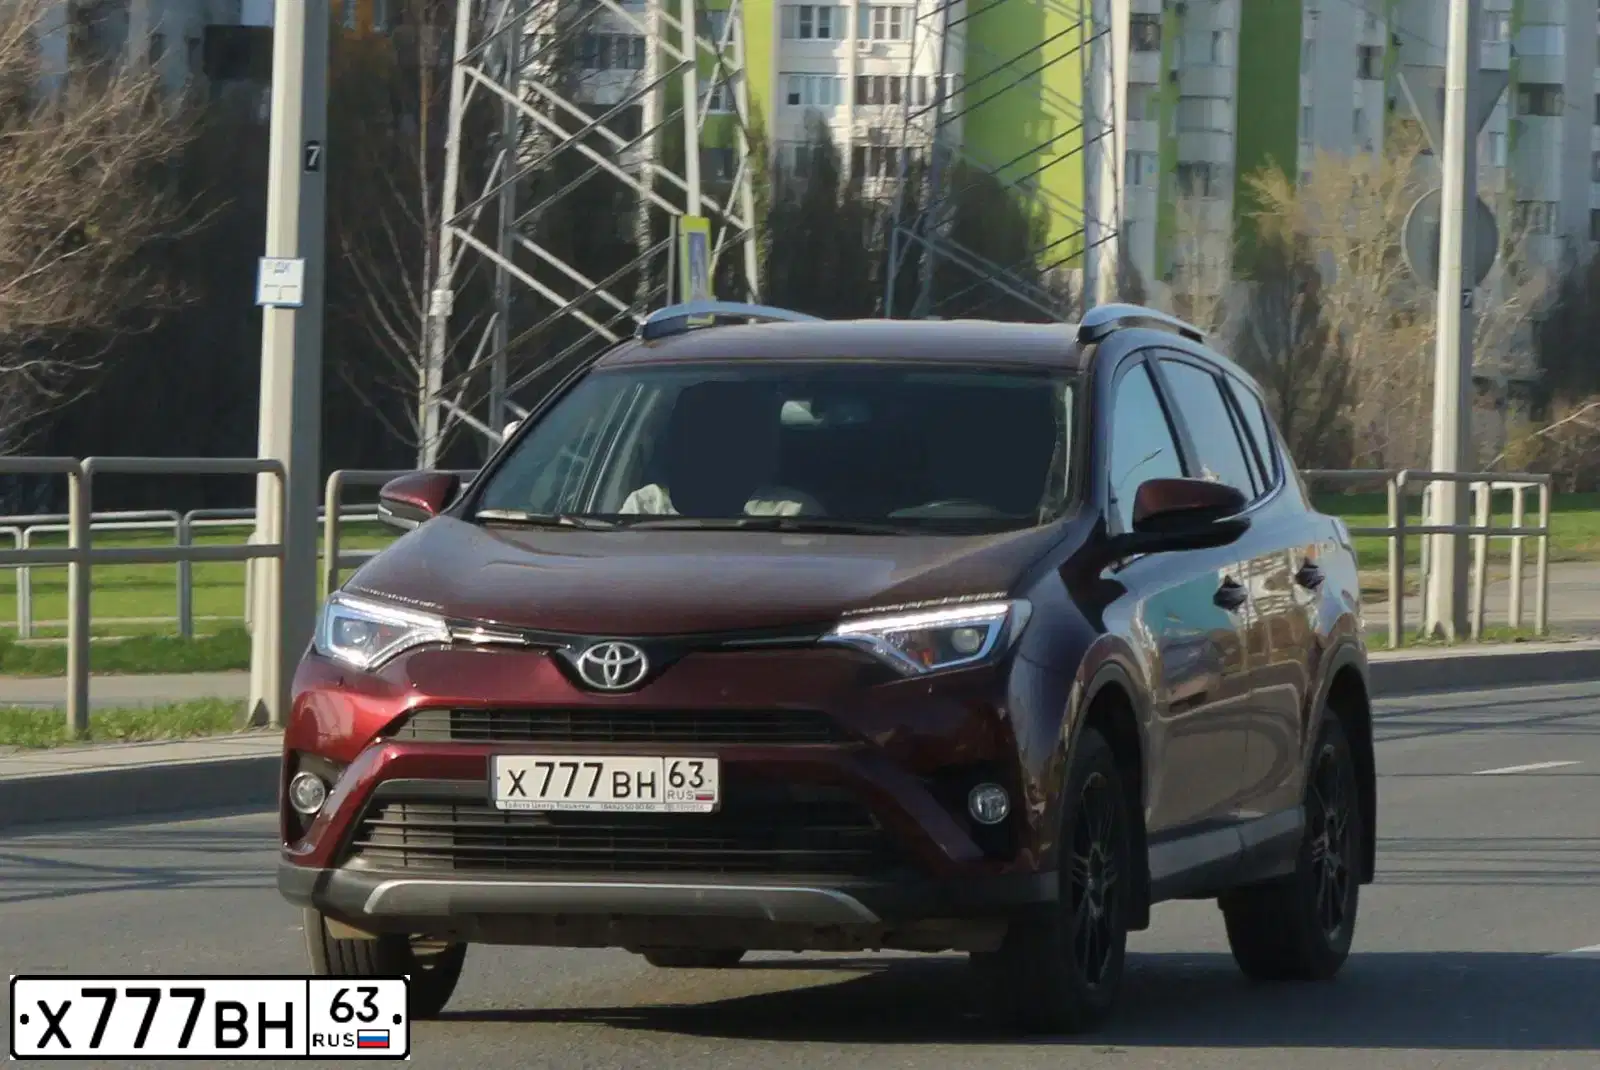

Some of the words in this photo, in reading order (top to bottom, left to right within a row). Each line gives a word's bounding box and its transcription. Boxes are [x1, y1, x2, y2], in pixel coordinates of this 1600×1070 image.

[308, 146, 320, 166] 7
[668, 760, 705, 789] 63
[667, 790, 694, 801] RUS
